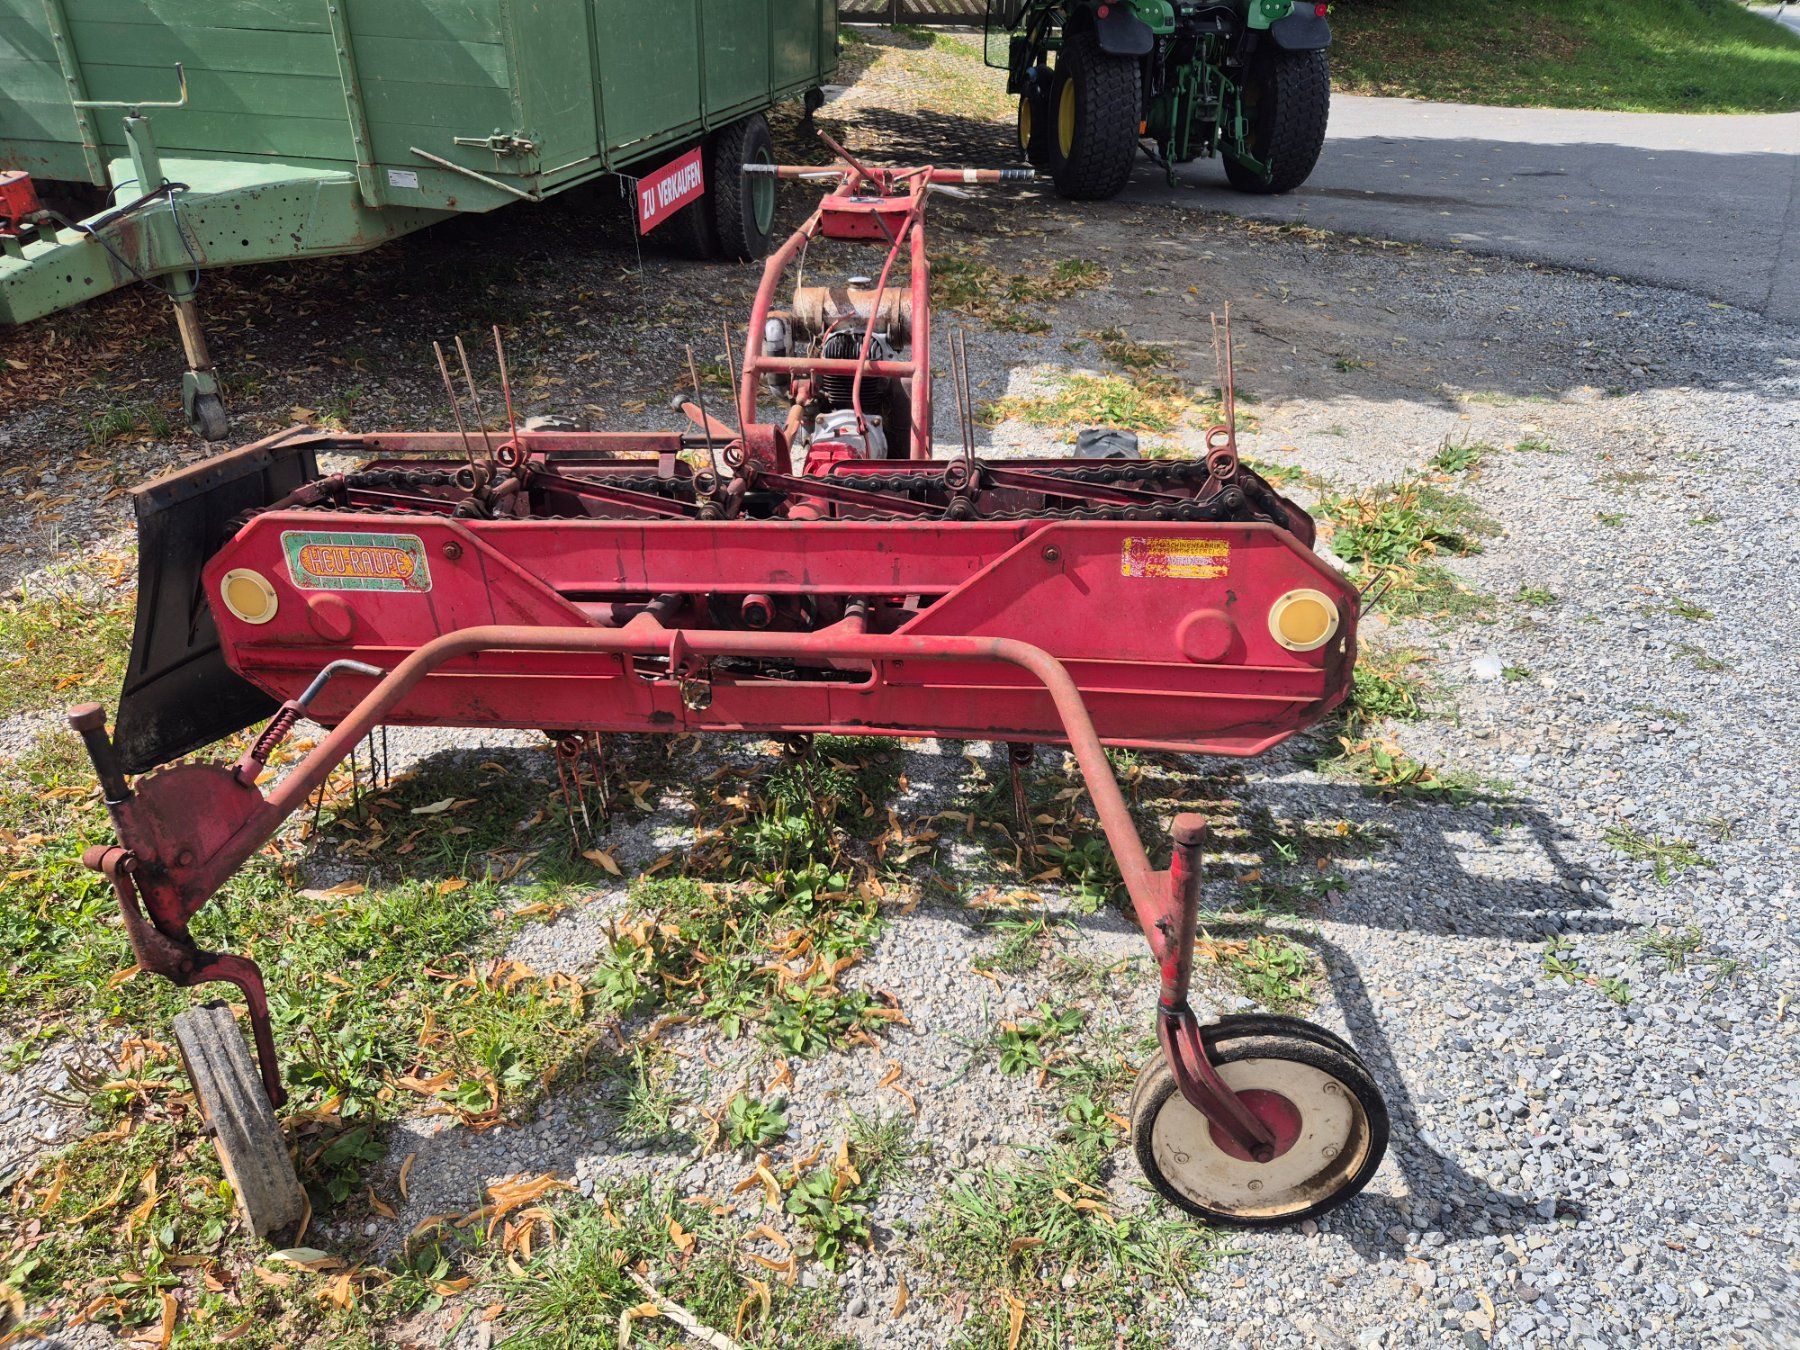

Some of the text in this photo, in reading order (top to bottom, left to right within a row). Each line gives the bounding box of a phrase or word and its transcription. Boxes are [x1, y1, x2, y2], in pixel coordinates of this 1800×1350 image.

[642, 160, 701, 220] ZU VERKAUFEN
[308, 549, 408, 575] HEU-RAUPE
